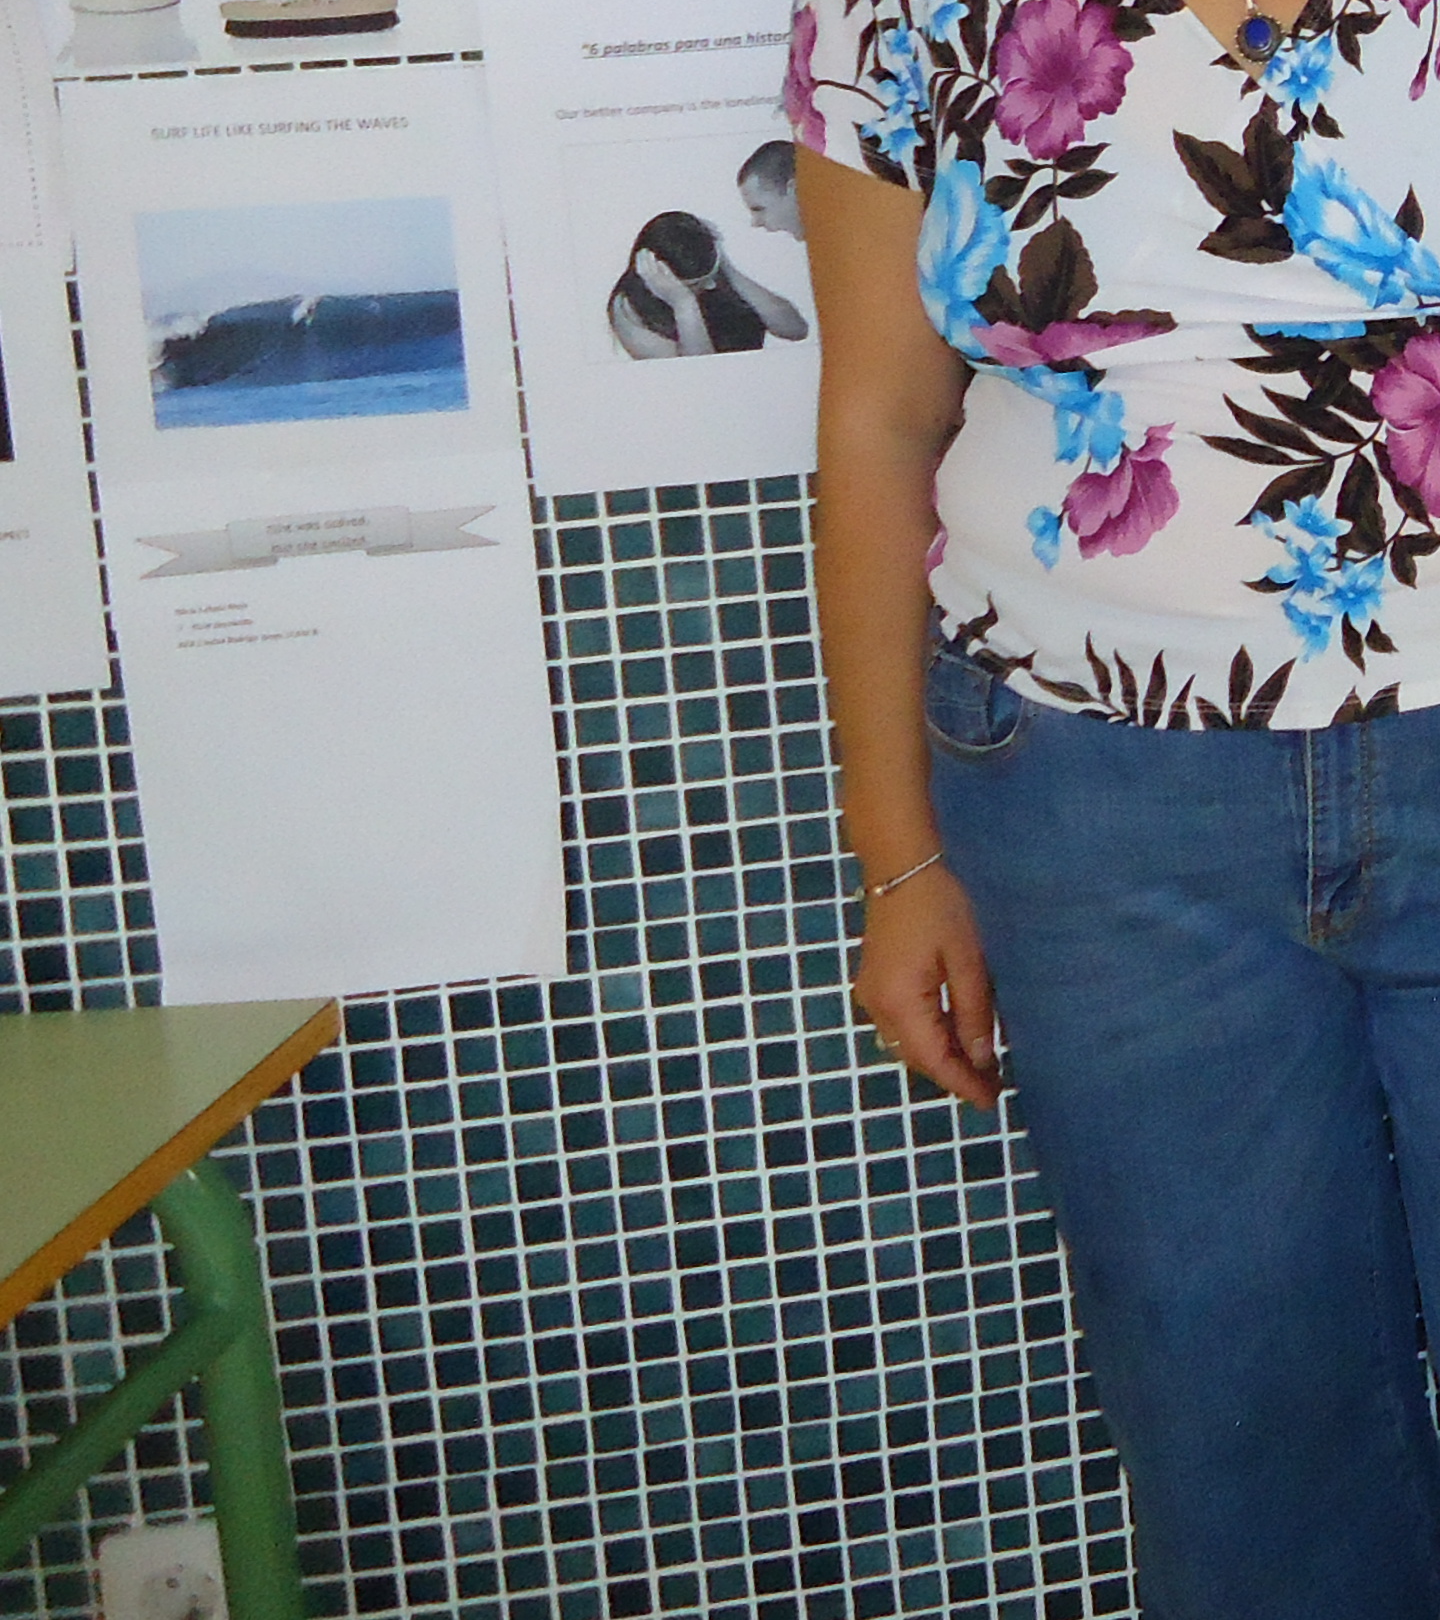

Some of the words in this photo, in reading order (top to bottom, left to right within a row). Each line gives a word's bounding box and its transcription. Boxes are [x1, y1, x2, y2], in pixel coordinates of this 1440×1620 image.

[603, 40, 670, 58] palabras
[674, 37, 709, 53] para
[713, 35, 742, 47] una
[745, 31, 790, 45] histor
[150, 125, 188, 139] SURF
[226, 123, 252, 137] LIKE
[258, 120, 321, 136] SURFING
[325, 119, 353, 132] THE
[356, 116, 408, 130] WAVES
